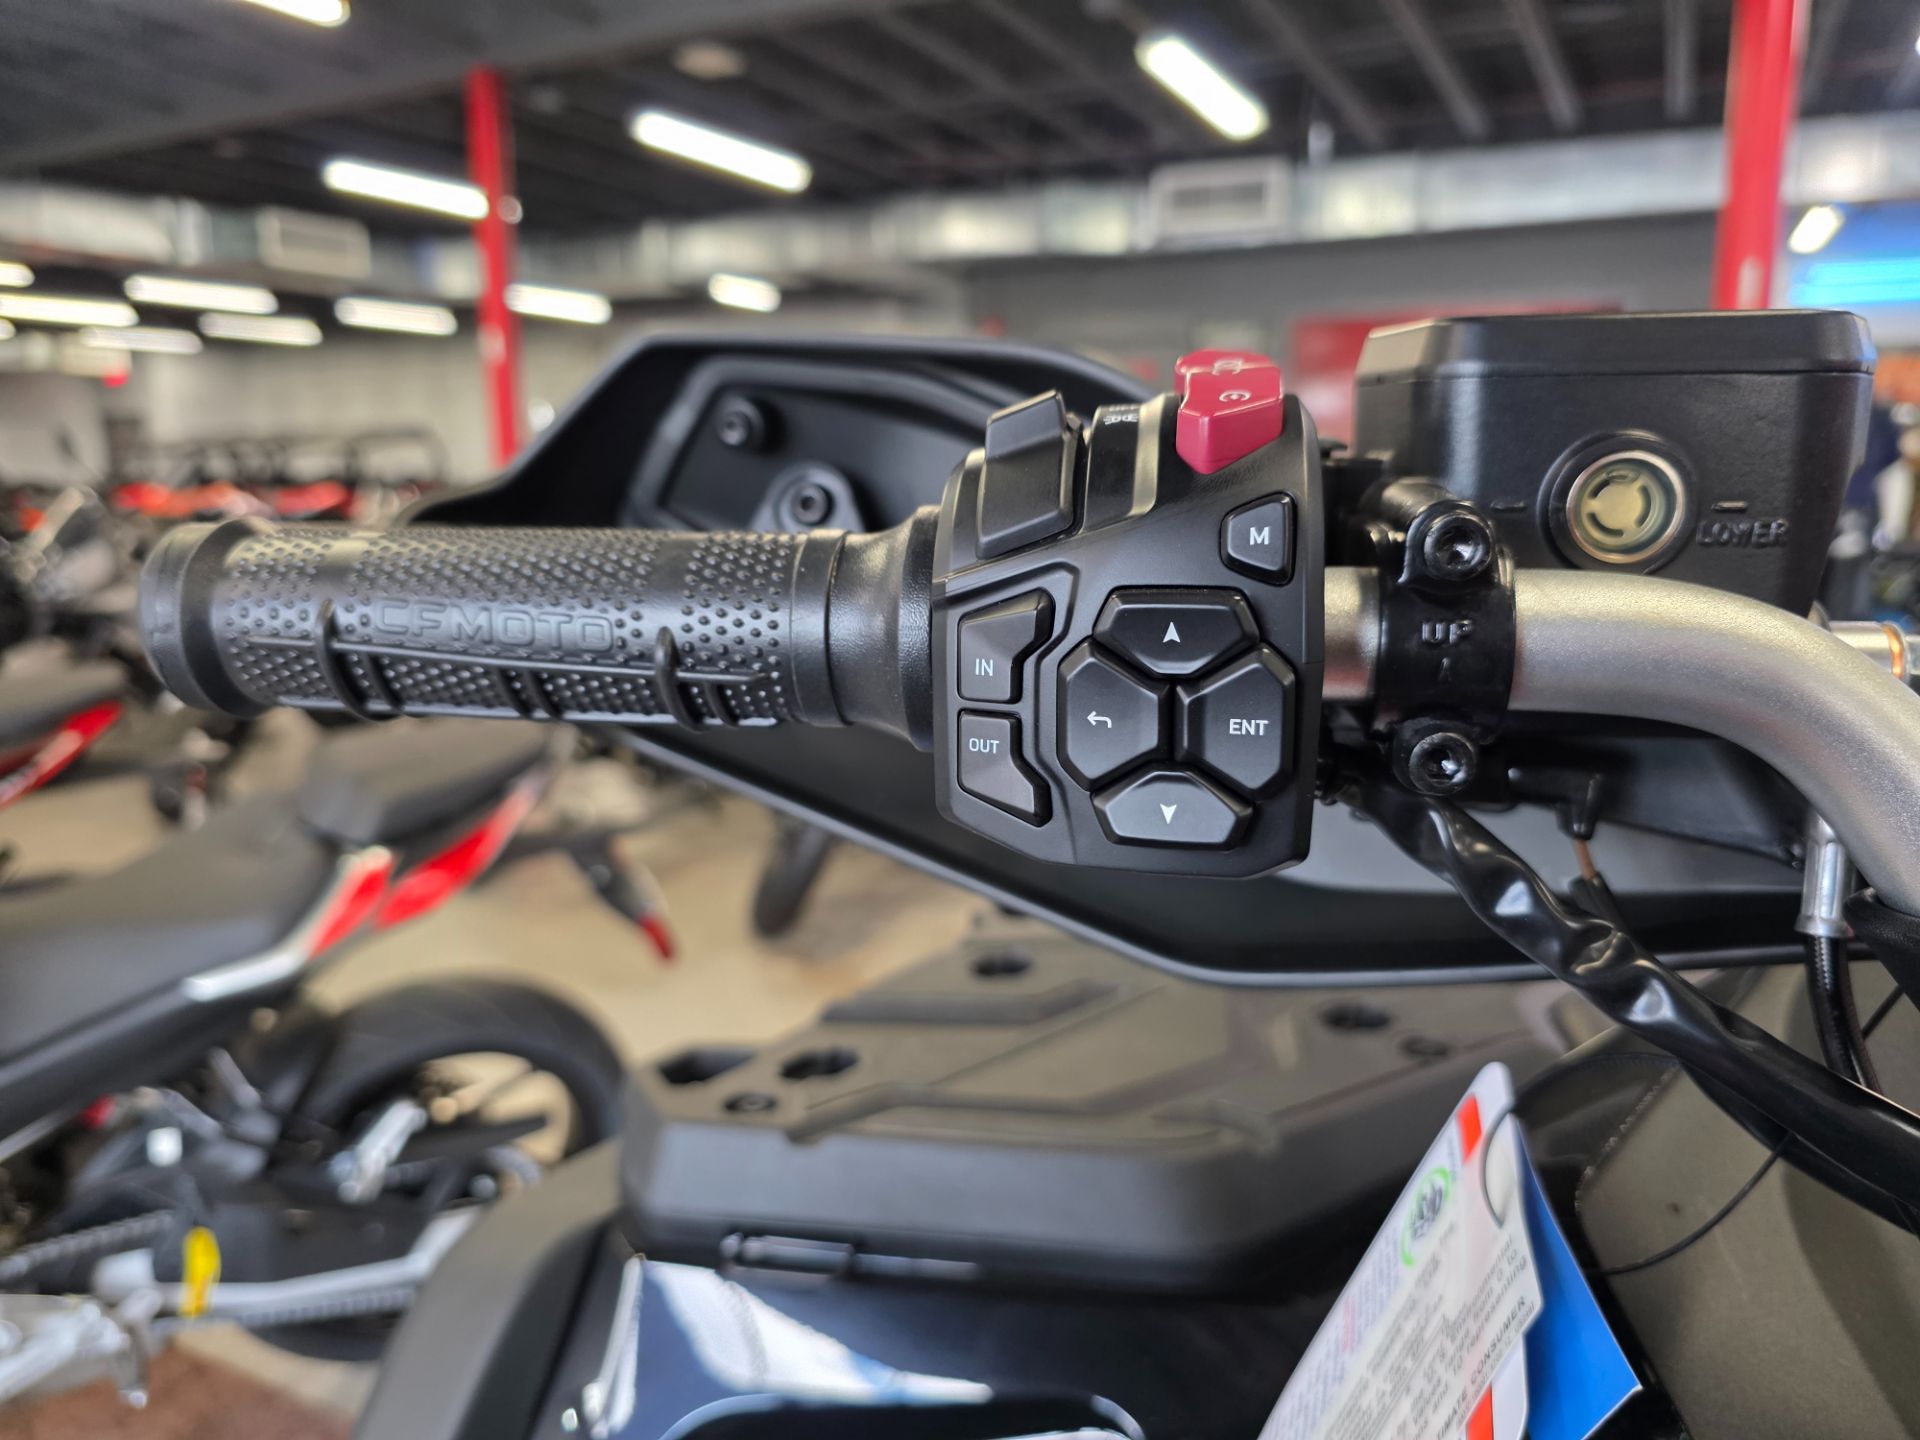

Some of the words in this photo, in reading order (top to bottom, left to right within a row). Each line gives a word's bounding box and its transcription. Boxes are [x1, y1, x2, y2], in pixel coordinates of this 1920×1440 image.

[1249, 526, 1270, 546] M
[1696, 518, 1789, 548] LOWER
[374, 600, 613, 651] CFMOTO
[1422, 620, 1472, 644] UP
[975, 658, 994, 677] IN
[1229, 718, 1269, 736] ENT
[968, 737, 1000, 754] OUT
[1465, 1252, 1527, 1356] representing
[1469, 1293, 1525, 1388] CONSUMER
